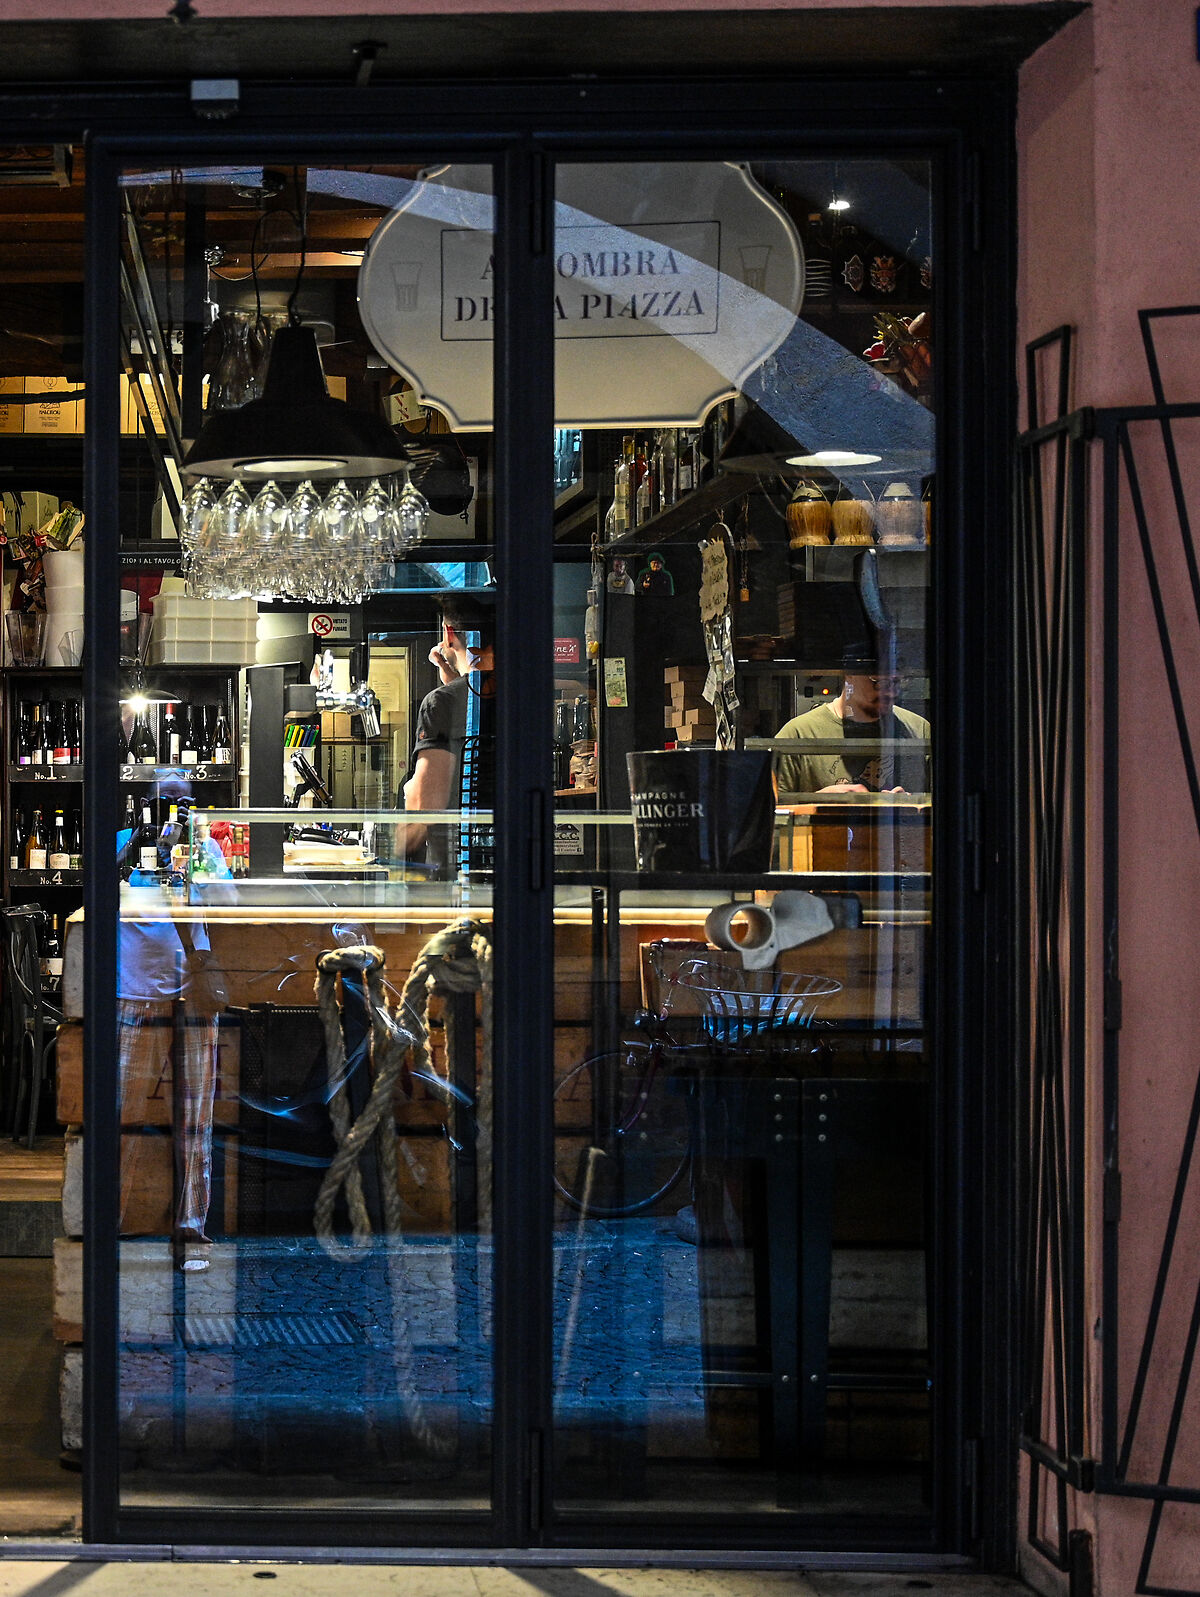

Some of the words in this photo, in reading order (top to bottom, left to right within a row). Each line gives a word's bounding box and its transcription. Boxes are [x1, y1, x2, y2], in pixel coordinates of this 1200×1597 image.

[454, 294, 569, 322] DEA
[579, 288, 705, 320] PIAZZA
[631, 791, 686, 800] AMPAGNE
[634, 803, 705, 819] LLINGER
